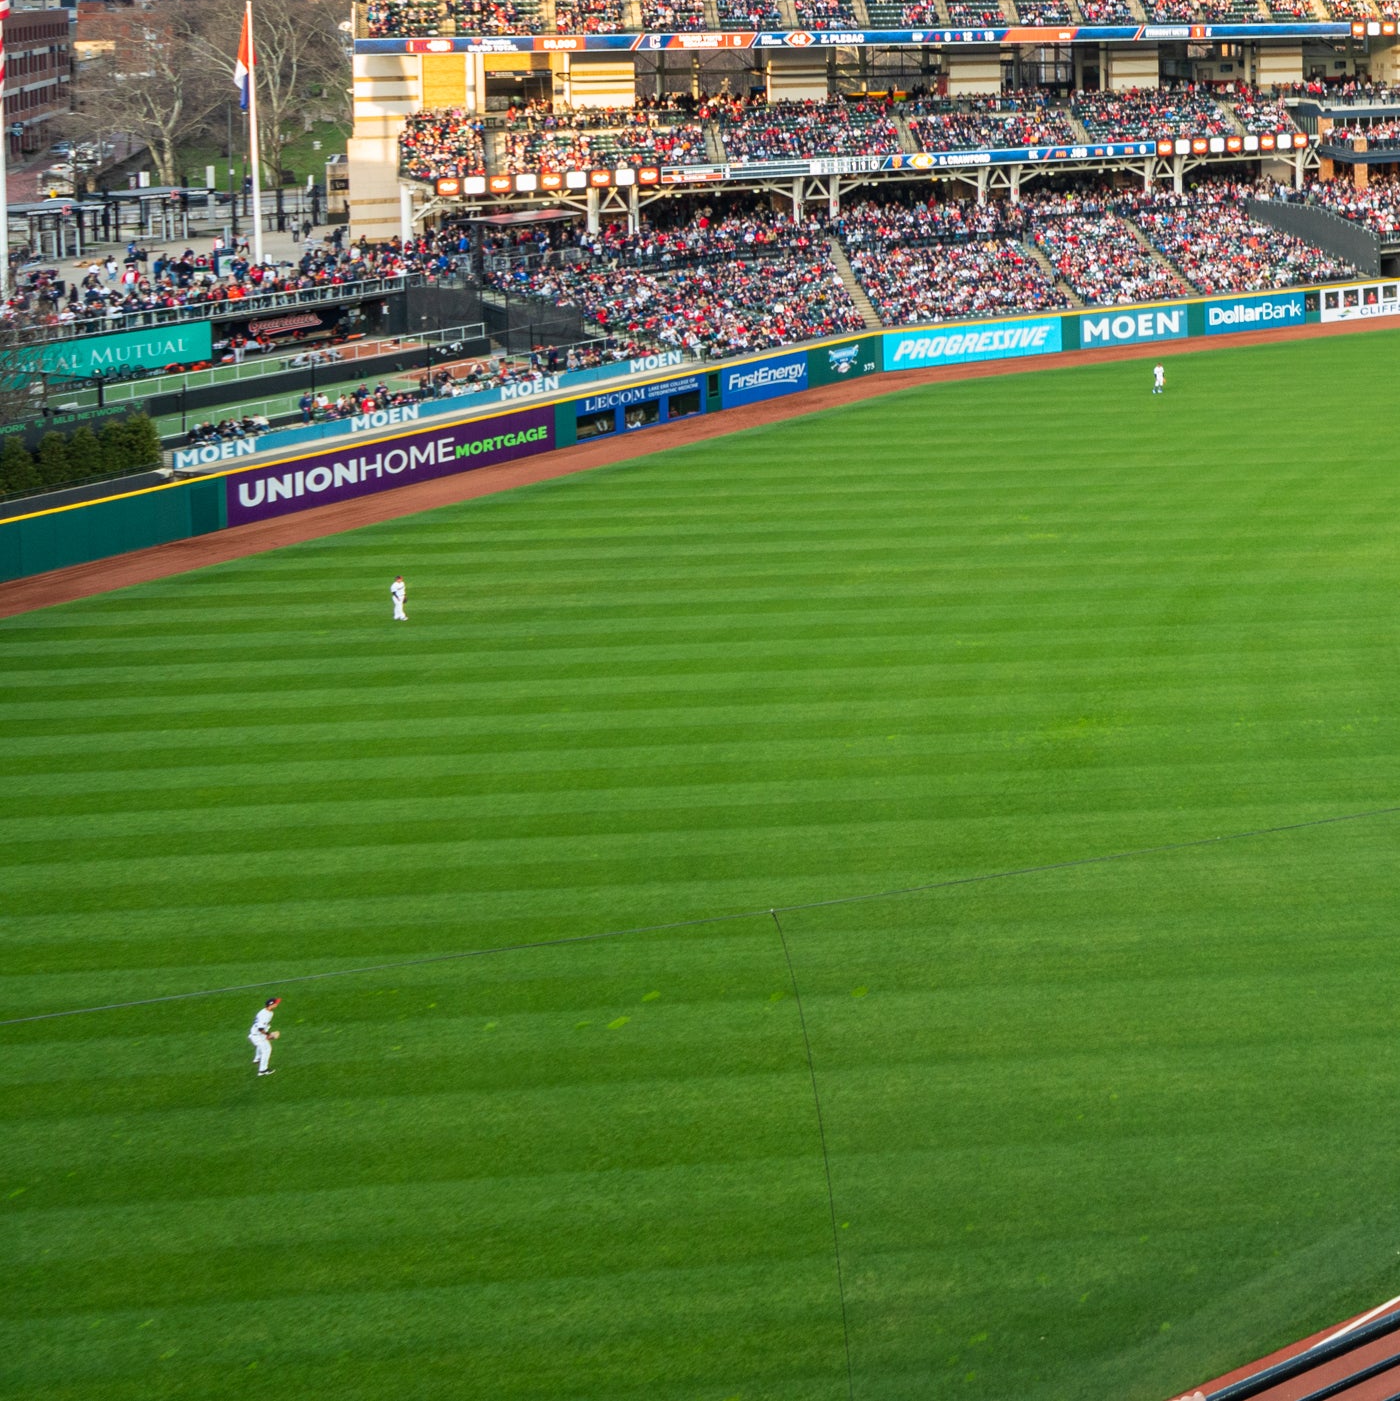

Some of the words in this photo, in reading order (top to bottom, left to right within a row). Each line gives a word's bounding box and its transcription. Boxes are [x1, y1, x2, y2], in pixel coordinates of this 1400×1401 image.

[792, 33, 806, 45] 42
[947, 153, 991, 165] CRAWFORD
[1083, 310, 1181, 343] MOEN
[1208, 302, 1301, 327] DollarBank
[90, 338, 188, 366] MUTUAL
[893, 325, 1051, 362] PROGRESSIVE
[630, 350, 683, 374] MOEN
[864, 362, 875, 372] 375
[501, 375, 559, 401] MOEN
[648, 384, 660, 392] LAKE
[670, 379, 688, 388] COLLEGE
[678, 383, 699, 392] MEDICINE
[728, 362, 807, 392] FirstEnergy
[585, 386, 647, 413] LECOM
[53, 414, 75, 426] MLB
[77, 404, 127, 422] NETWORK
[351, 404, 419, 432] MOEN
[176, 438, 256, 469] MOEN
[455, 426, 548, 460] MORTGAGE
